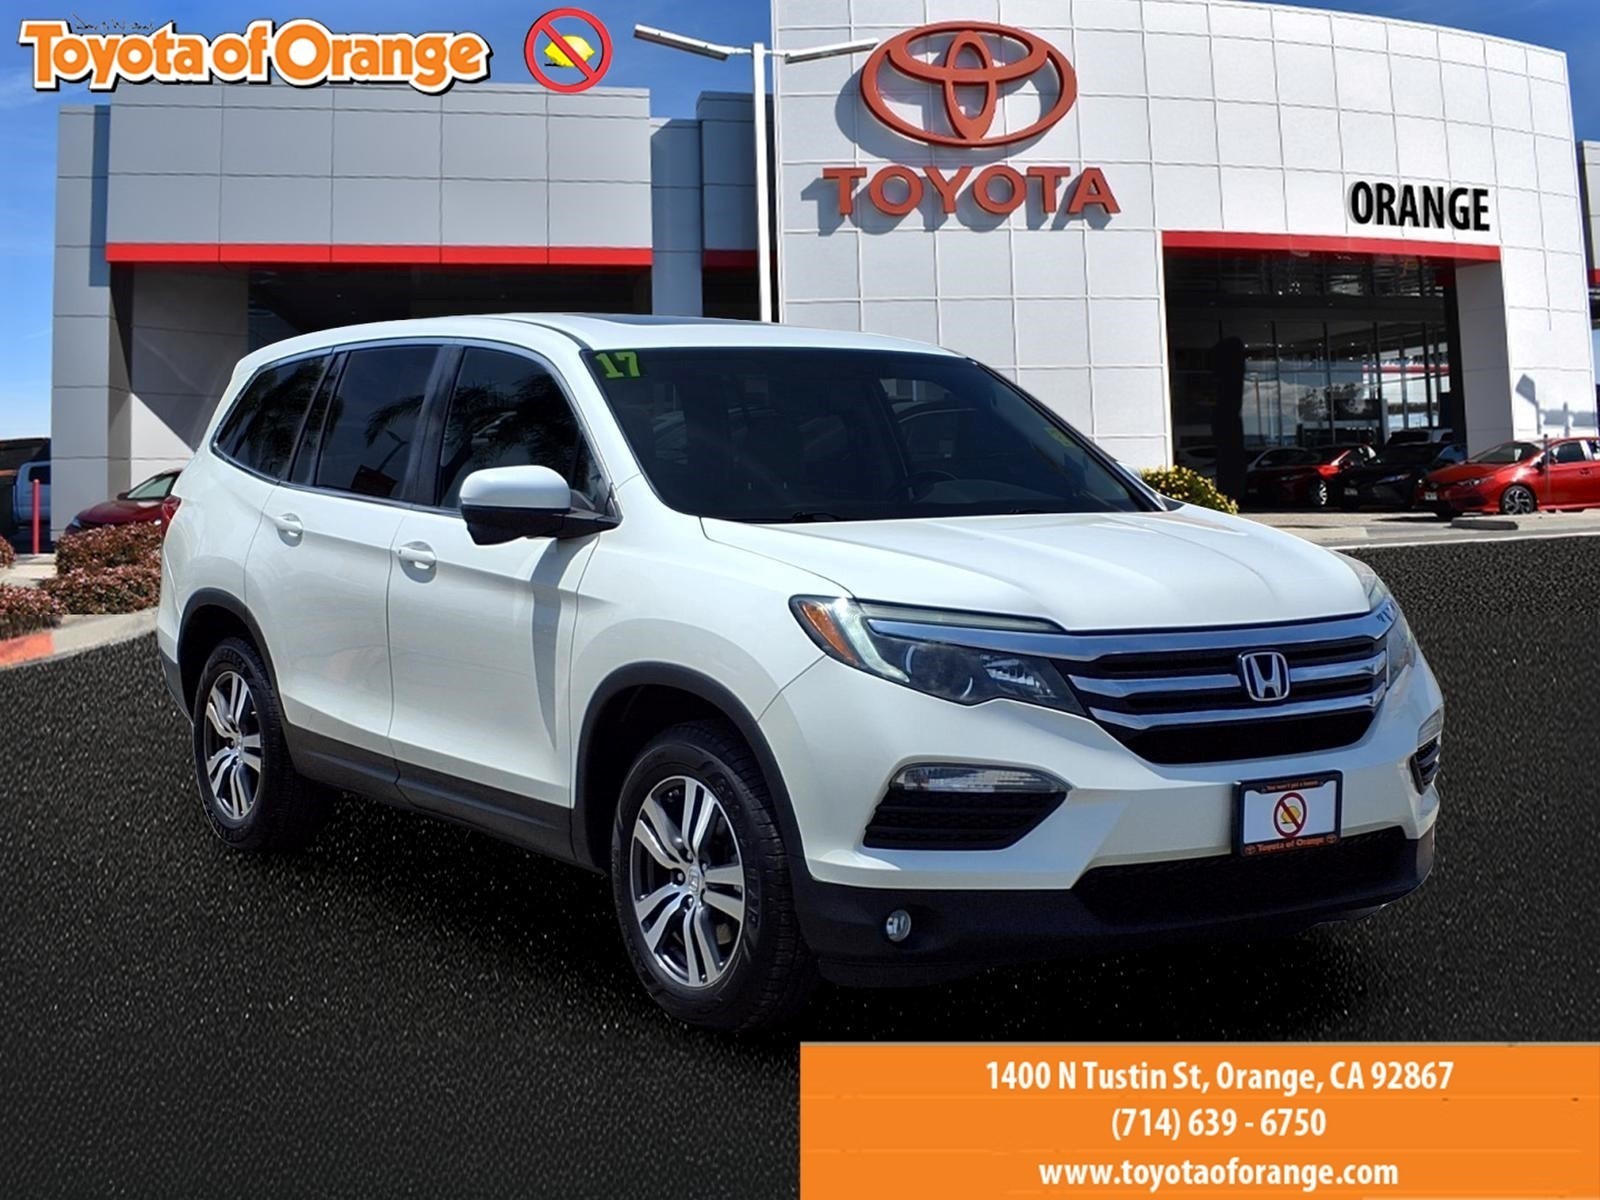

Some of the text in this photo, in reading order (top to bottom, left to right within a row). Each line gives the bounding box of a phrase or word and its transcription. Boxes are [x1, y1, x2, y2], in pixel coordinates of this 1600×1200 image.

[822, 165, 1120, 216] TOYOTA
[1349, 181, 1490, 231] ORANGE
[595, 351, 641, 378] 17
